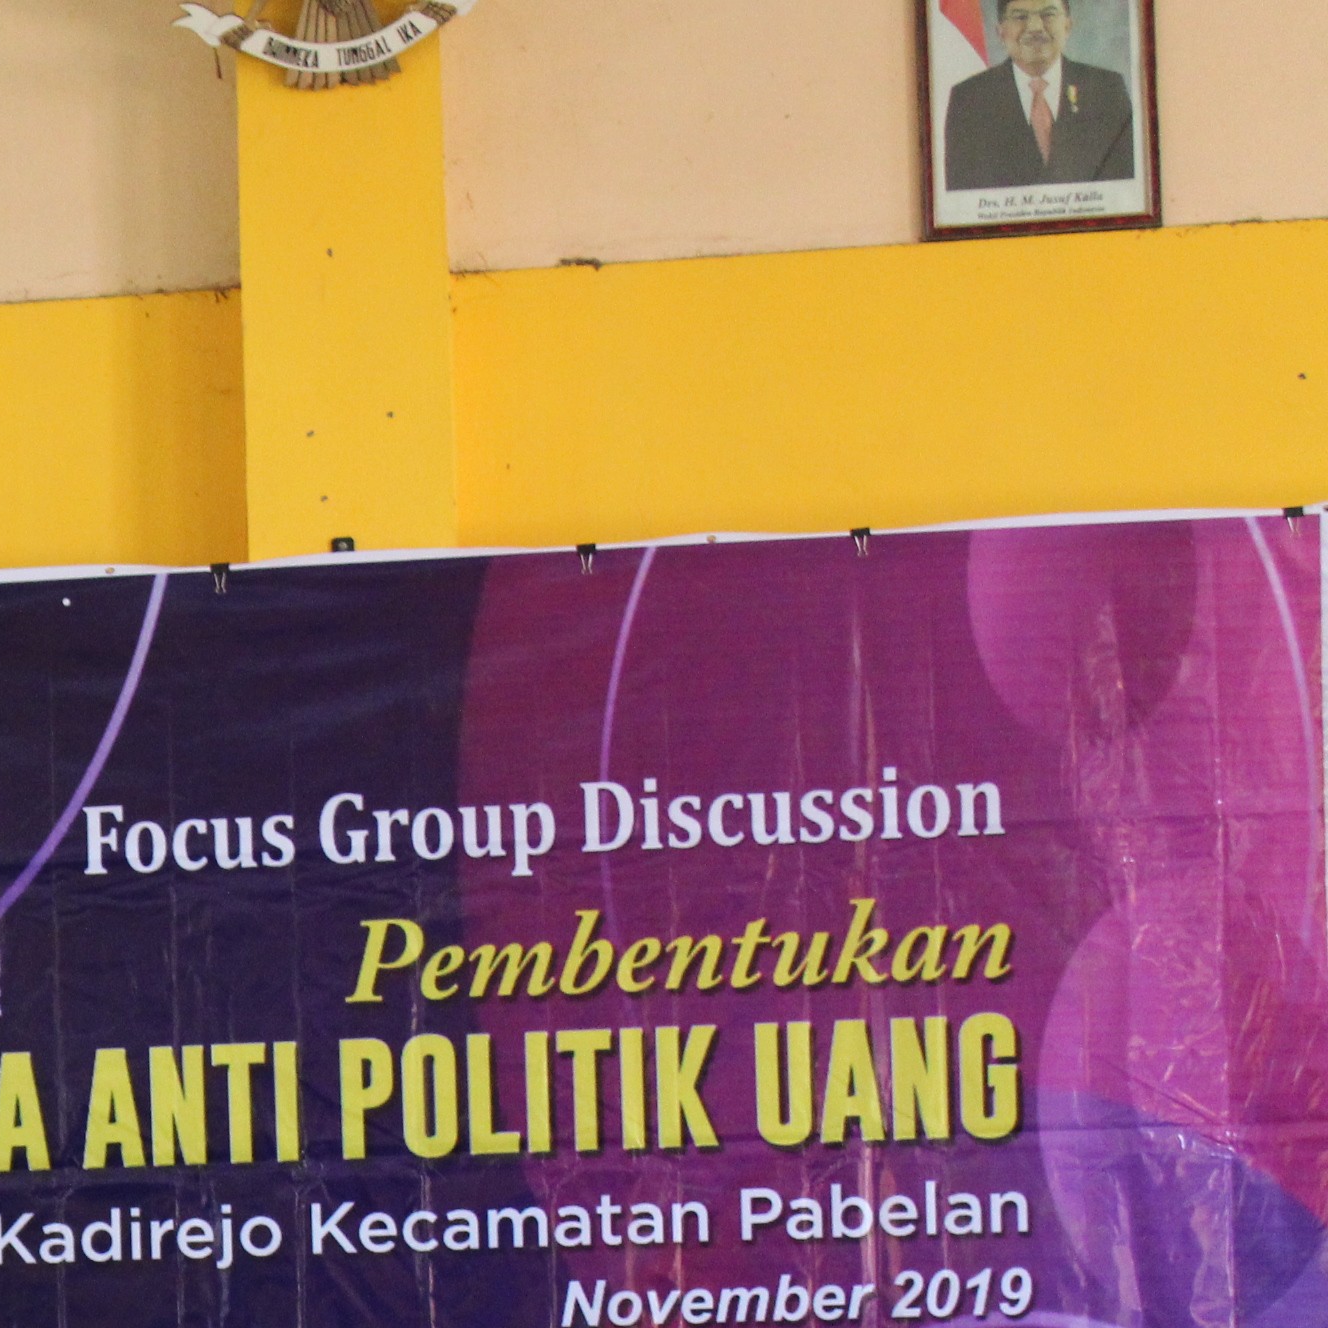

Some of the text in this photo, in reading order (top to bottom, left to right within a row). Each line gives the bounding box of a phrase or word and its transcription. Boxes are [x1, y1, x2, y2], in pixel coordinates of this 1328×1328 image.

[337, 35, 392, 66] TUNGGAL
[397, 21, 423, 45] IKA
[82, 766, 1005, 876] Focus Group Discussion
[345, 898, 1012, 1002] Pembentukan
[83, 1040, 300, 1170] ANTI
[339, 1024, 719, 1160] POLITIK
[754, 1012, 1019, 1146] UANG
[311, 1193, 709, 1254] Kecamatan
[741, 1181, 1029, 1240] Pabelan
[561, 1267, 1032, 1327] November 2019
